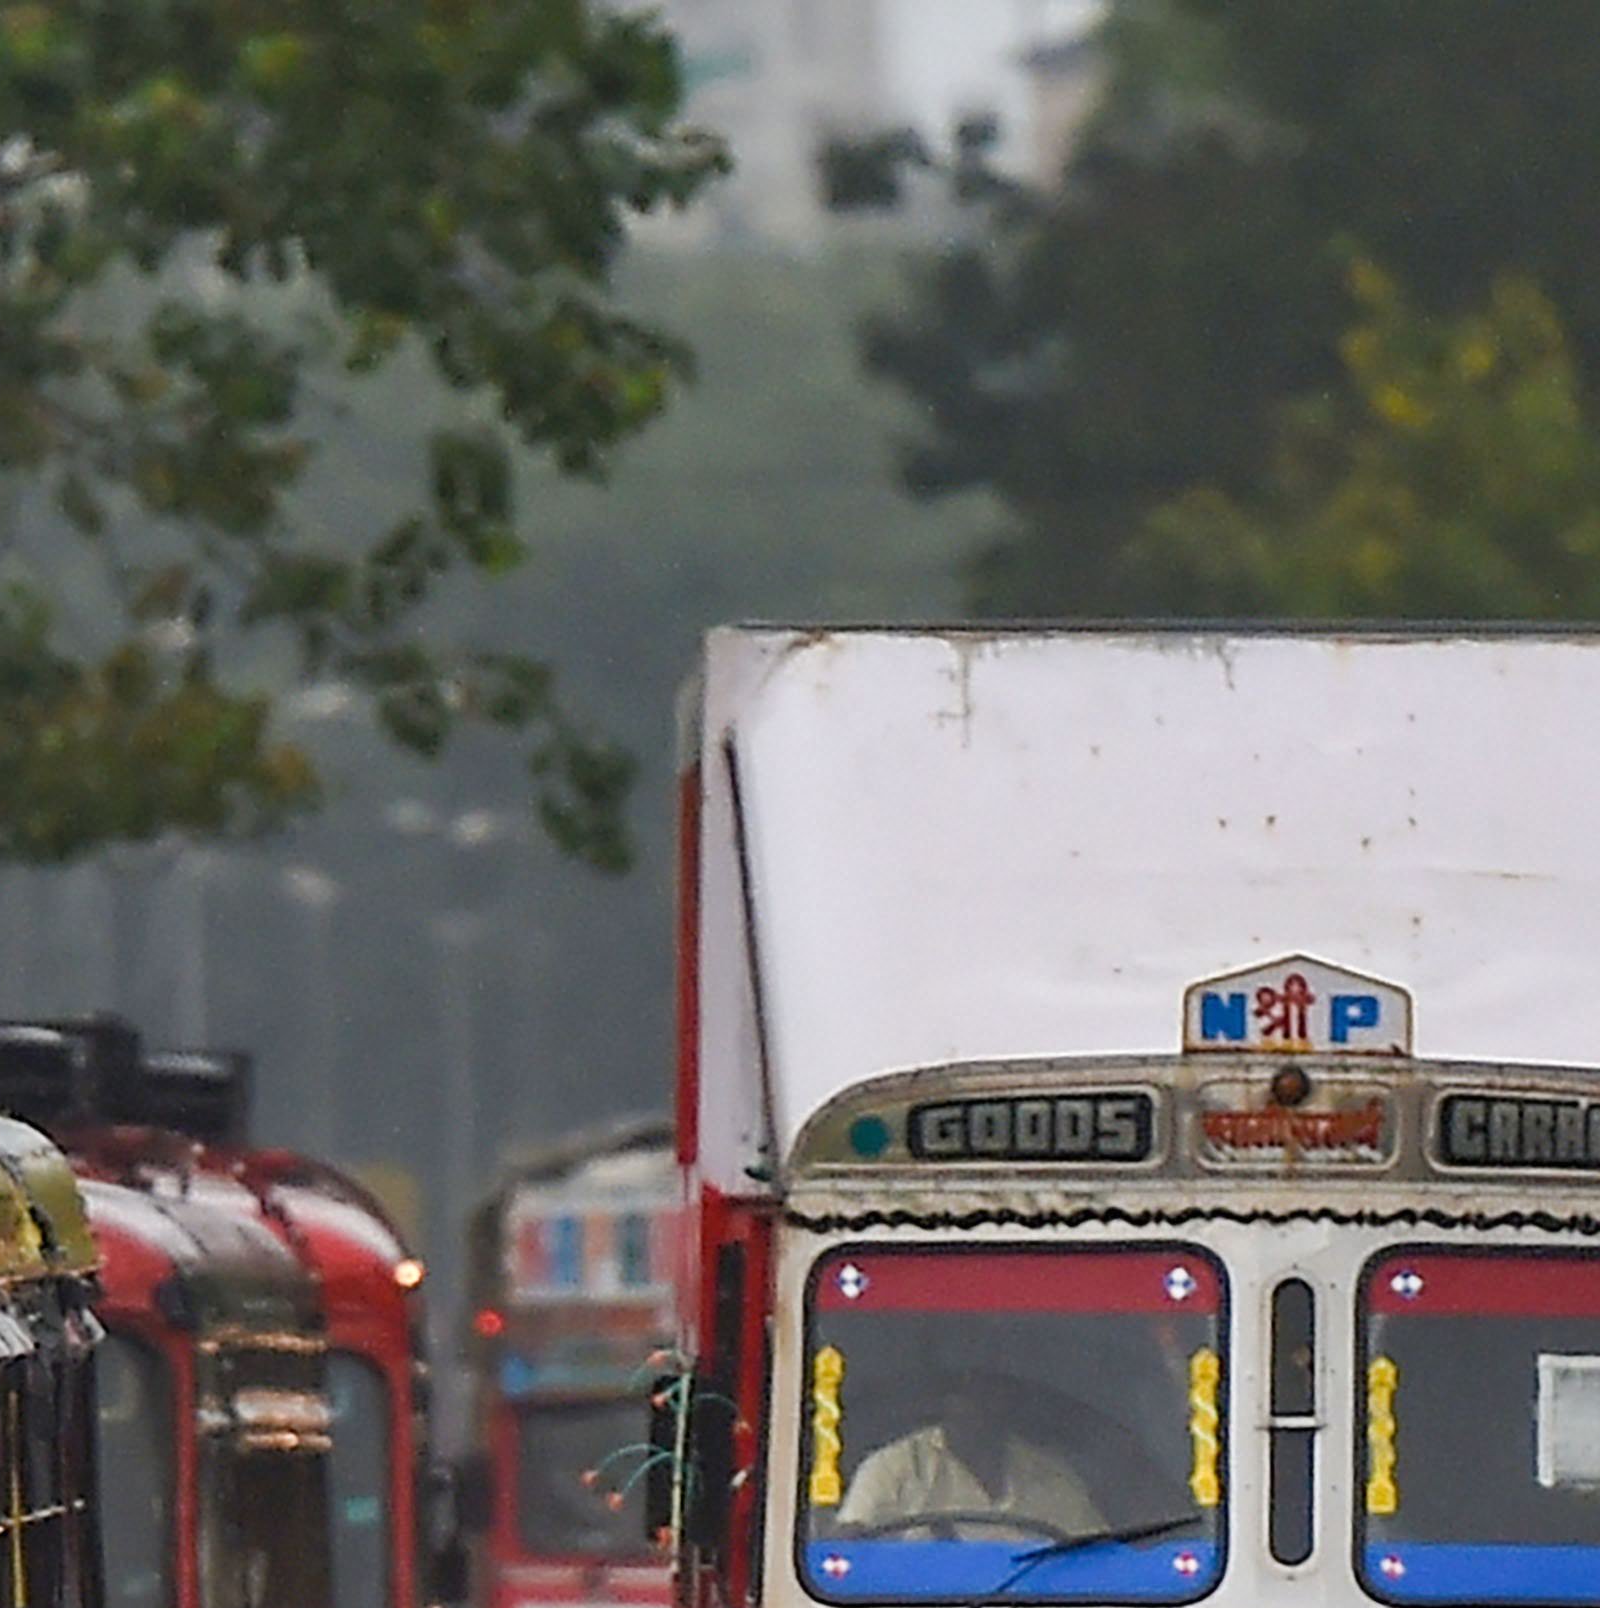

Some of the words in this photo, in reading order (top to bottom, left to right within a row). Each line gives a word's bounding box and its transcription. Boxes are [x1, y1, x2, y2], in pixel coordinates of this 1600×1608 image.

[1202, 992, 1247, 1040] N
[1254, 973, 1315, 1040] श्री
[1330, 993, 1380, 1043] P
[920, 1099, 1138, 1152] GOODS
